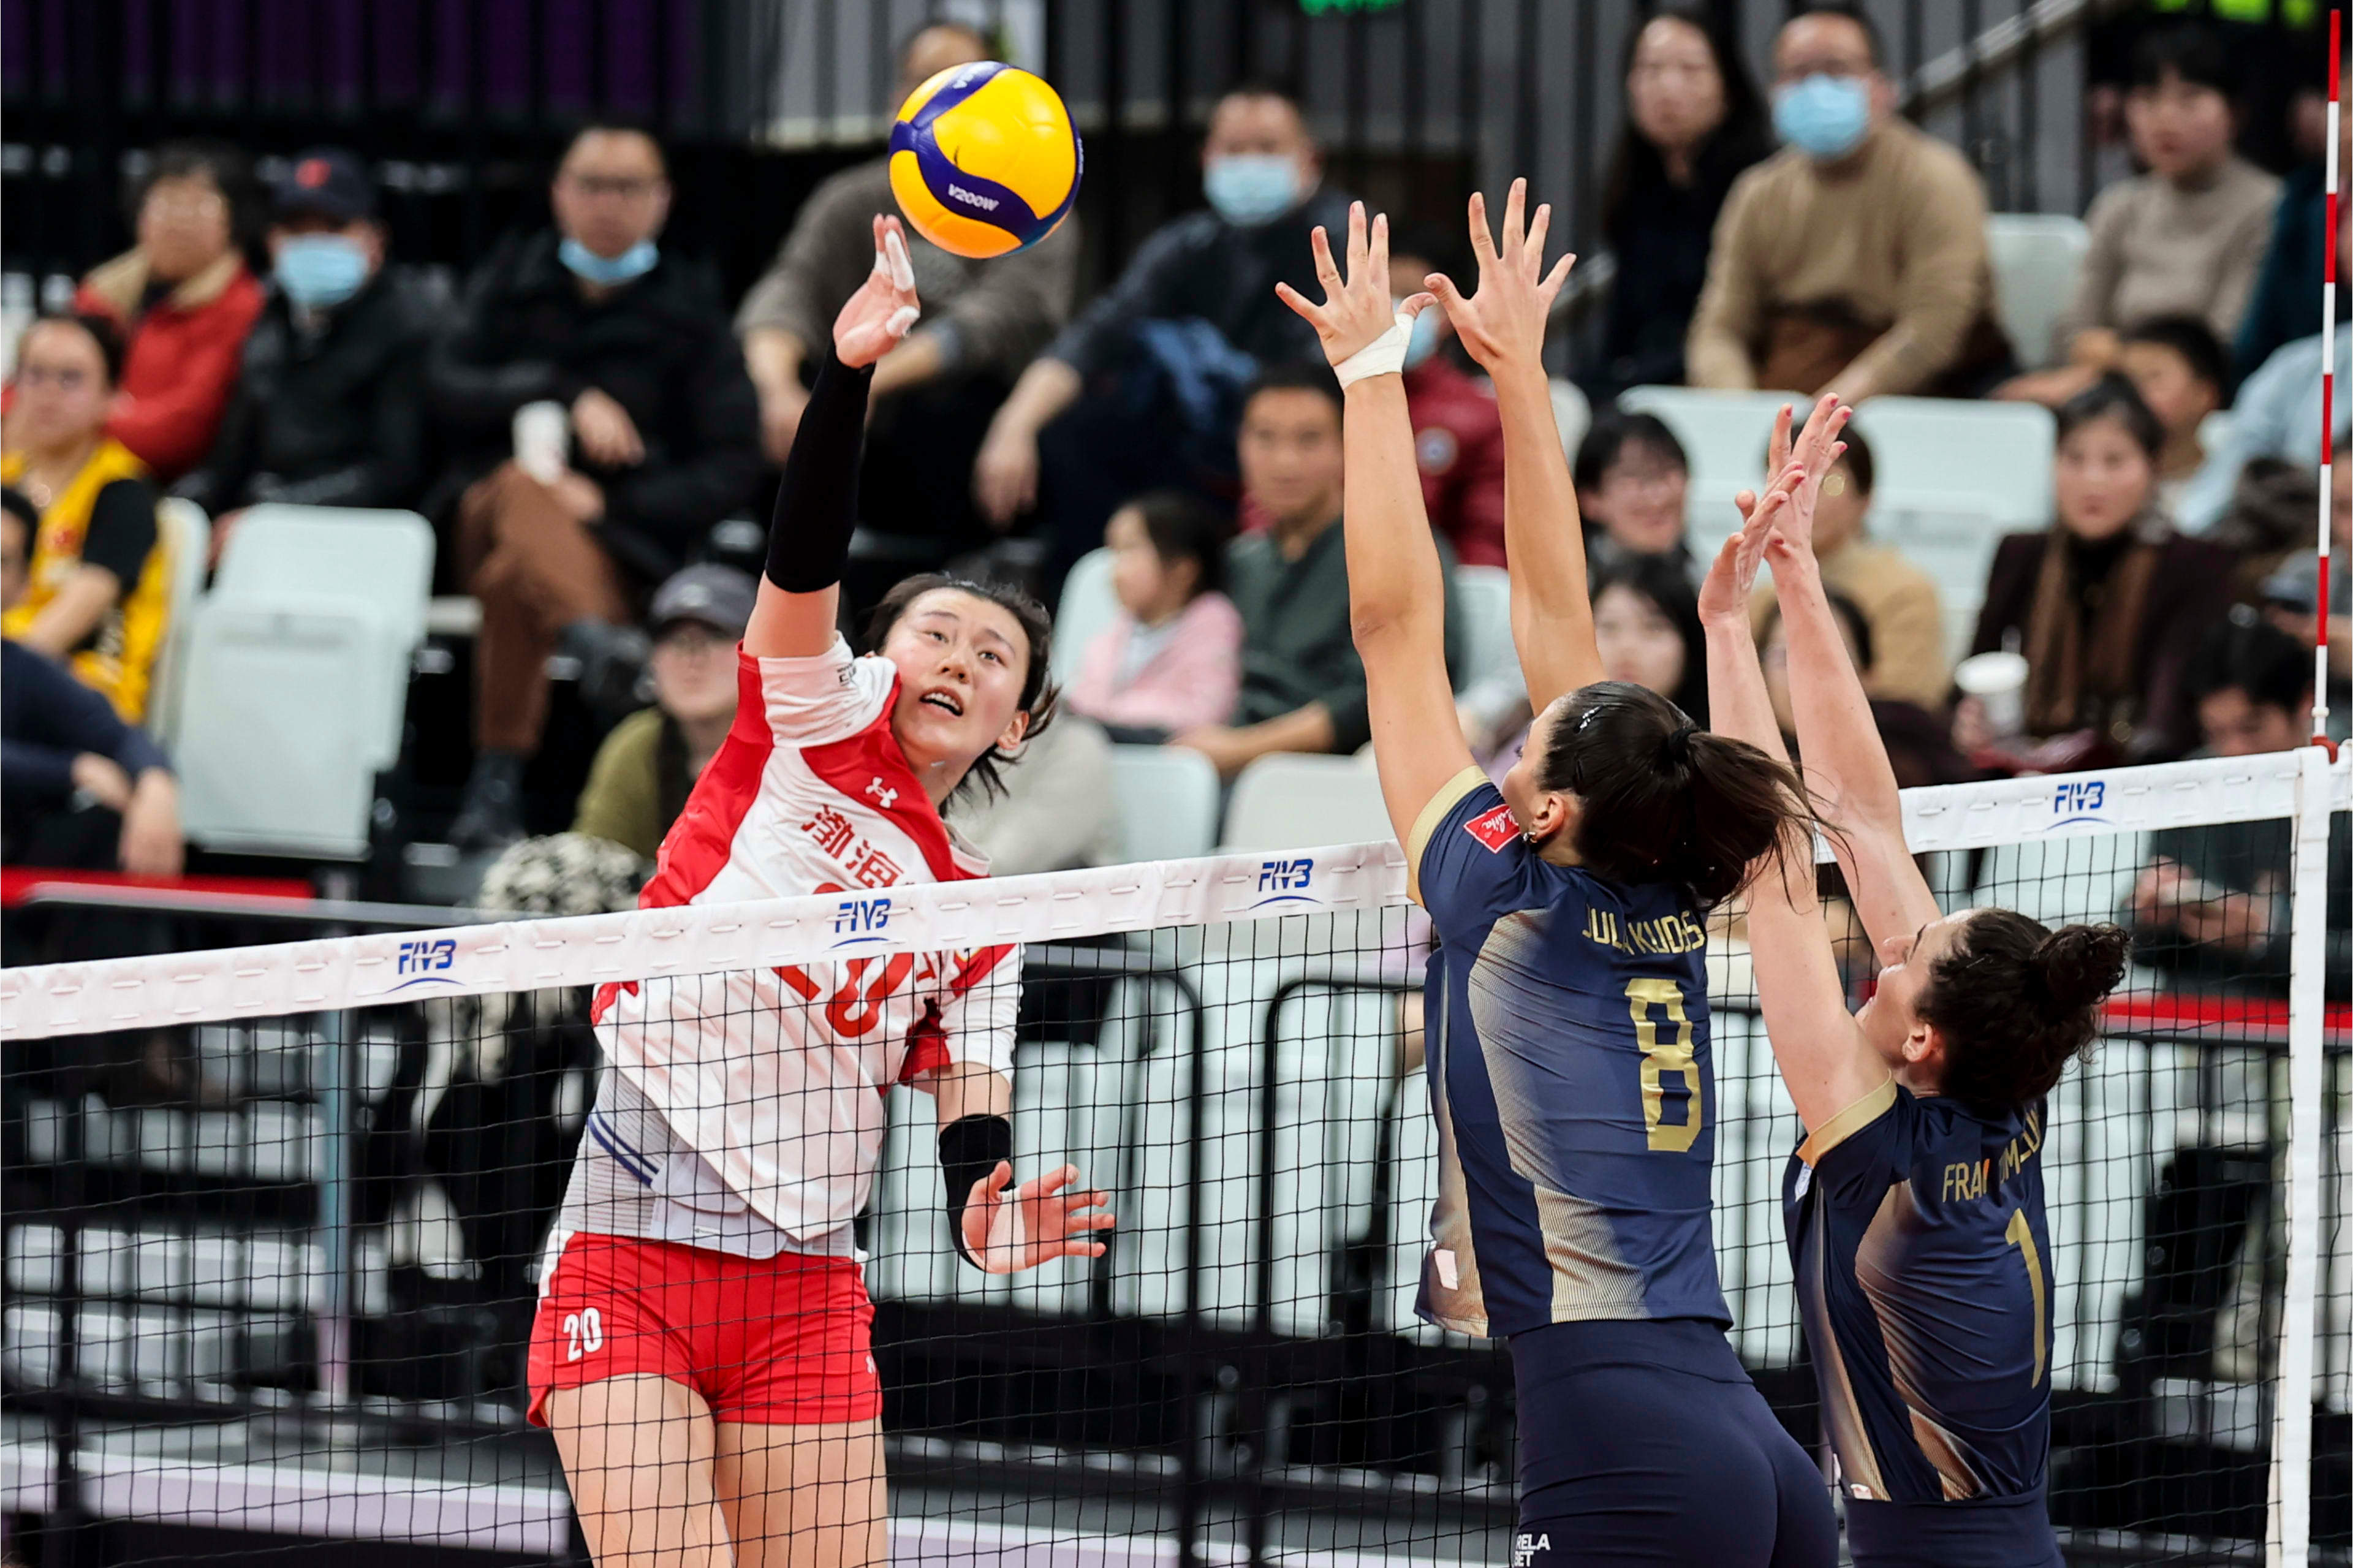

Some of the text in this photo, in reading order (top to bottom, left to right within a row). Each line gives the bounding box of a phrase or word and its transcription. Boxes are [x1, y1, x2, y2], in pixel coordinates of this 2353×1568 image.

[948, 183, 1000, 211] V200W
[2055, 781, 2105, 814] FIVB
[801, 803, 915, 888] 渤海
[1258, 858, 1313, 892] FIVB
[835, 899, 892, 933] FIVB
[398, 939, 457, 975] FIVB
[1624, 978, 1702, 1152] 8
[2005, 1208, 2046, 1390] 1
[563, 1306, 603, 1362] 20
